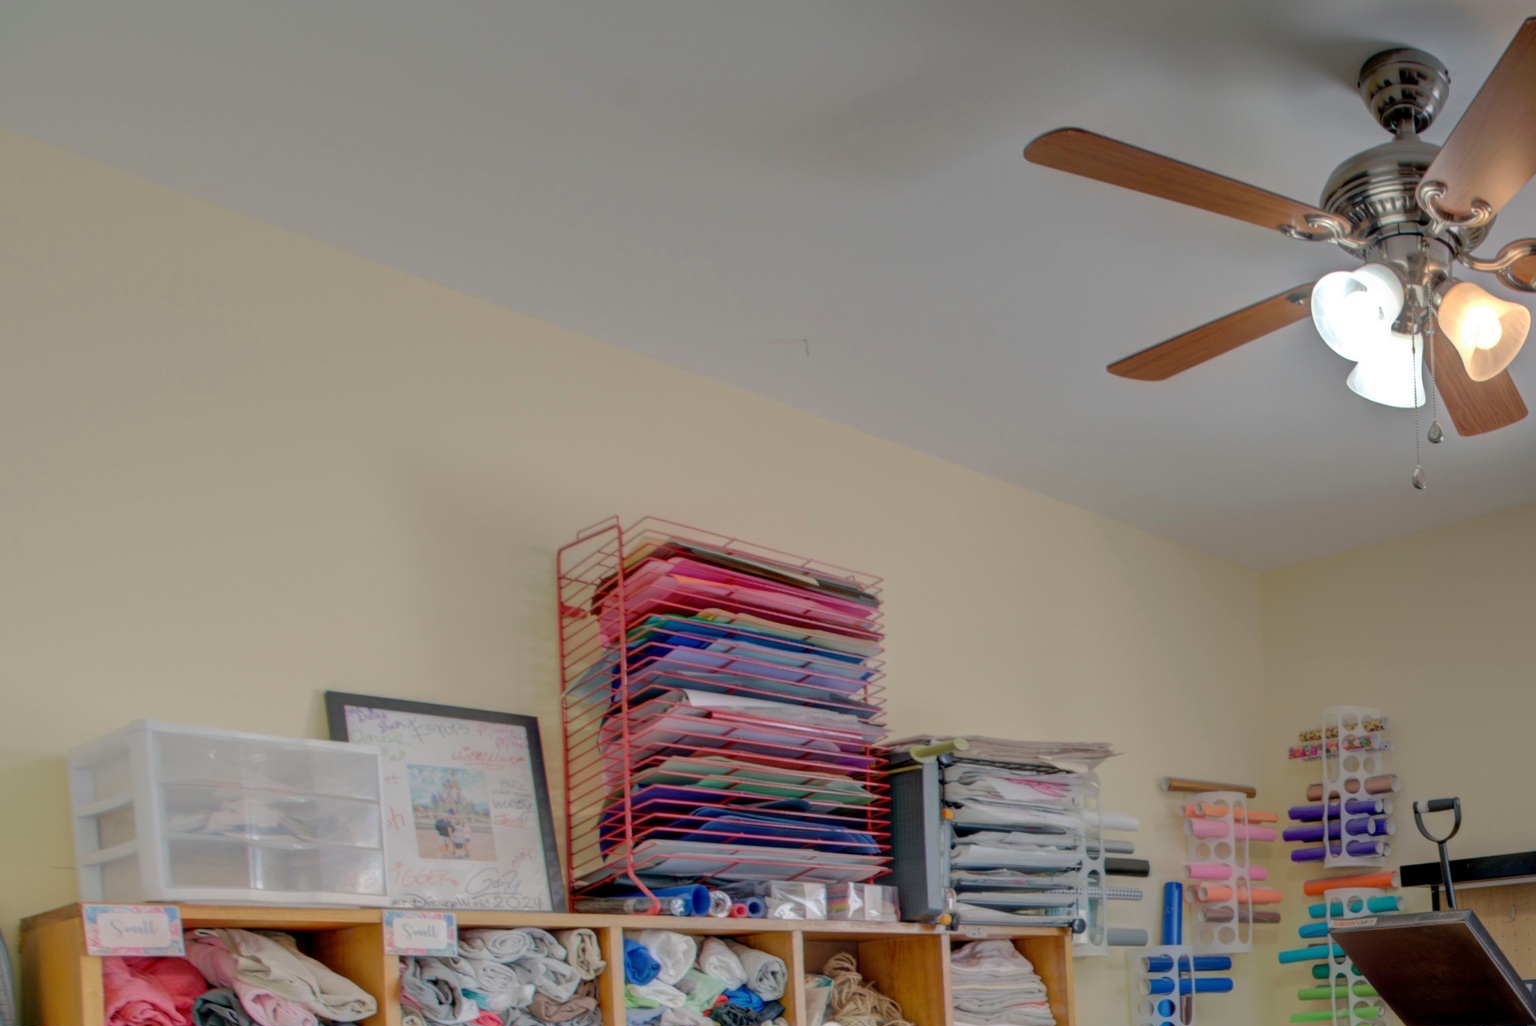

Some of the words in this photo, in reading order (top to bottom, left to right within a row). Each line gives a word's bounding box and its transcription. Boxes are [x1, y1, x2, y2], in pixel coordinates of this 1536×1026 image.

[493, 895, 543, 909] 2024
[110, 920, 155, 938] Small
[403, 924, 438, 940] Small
